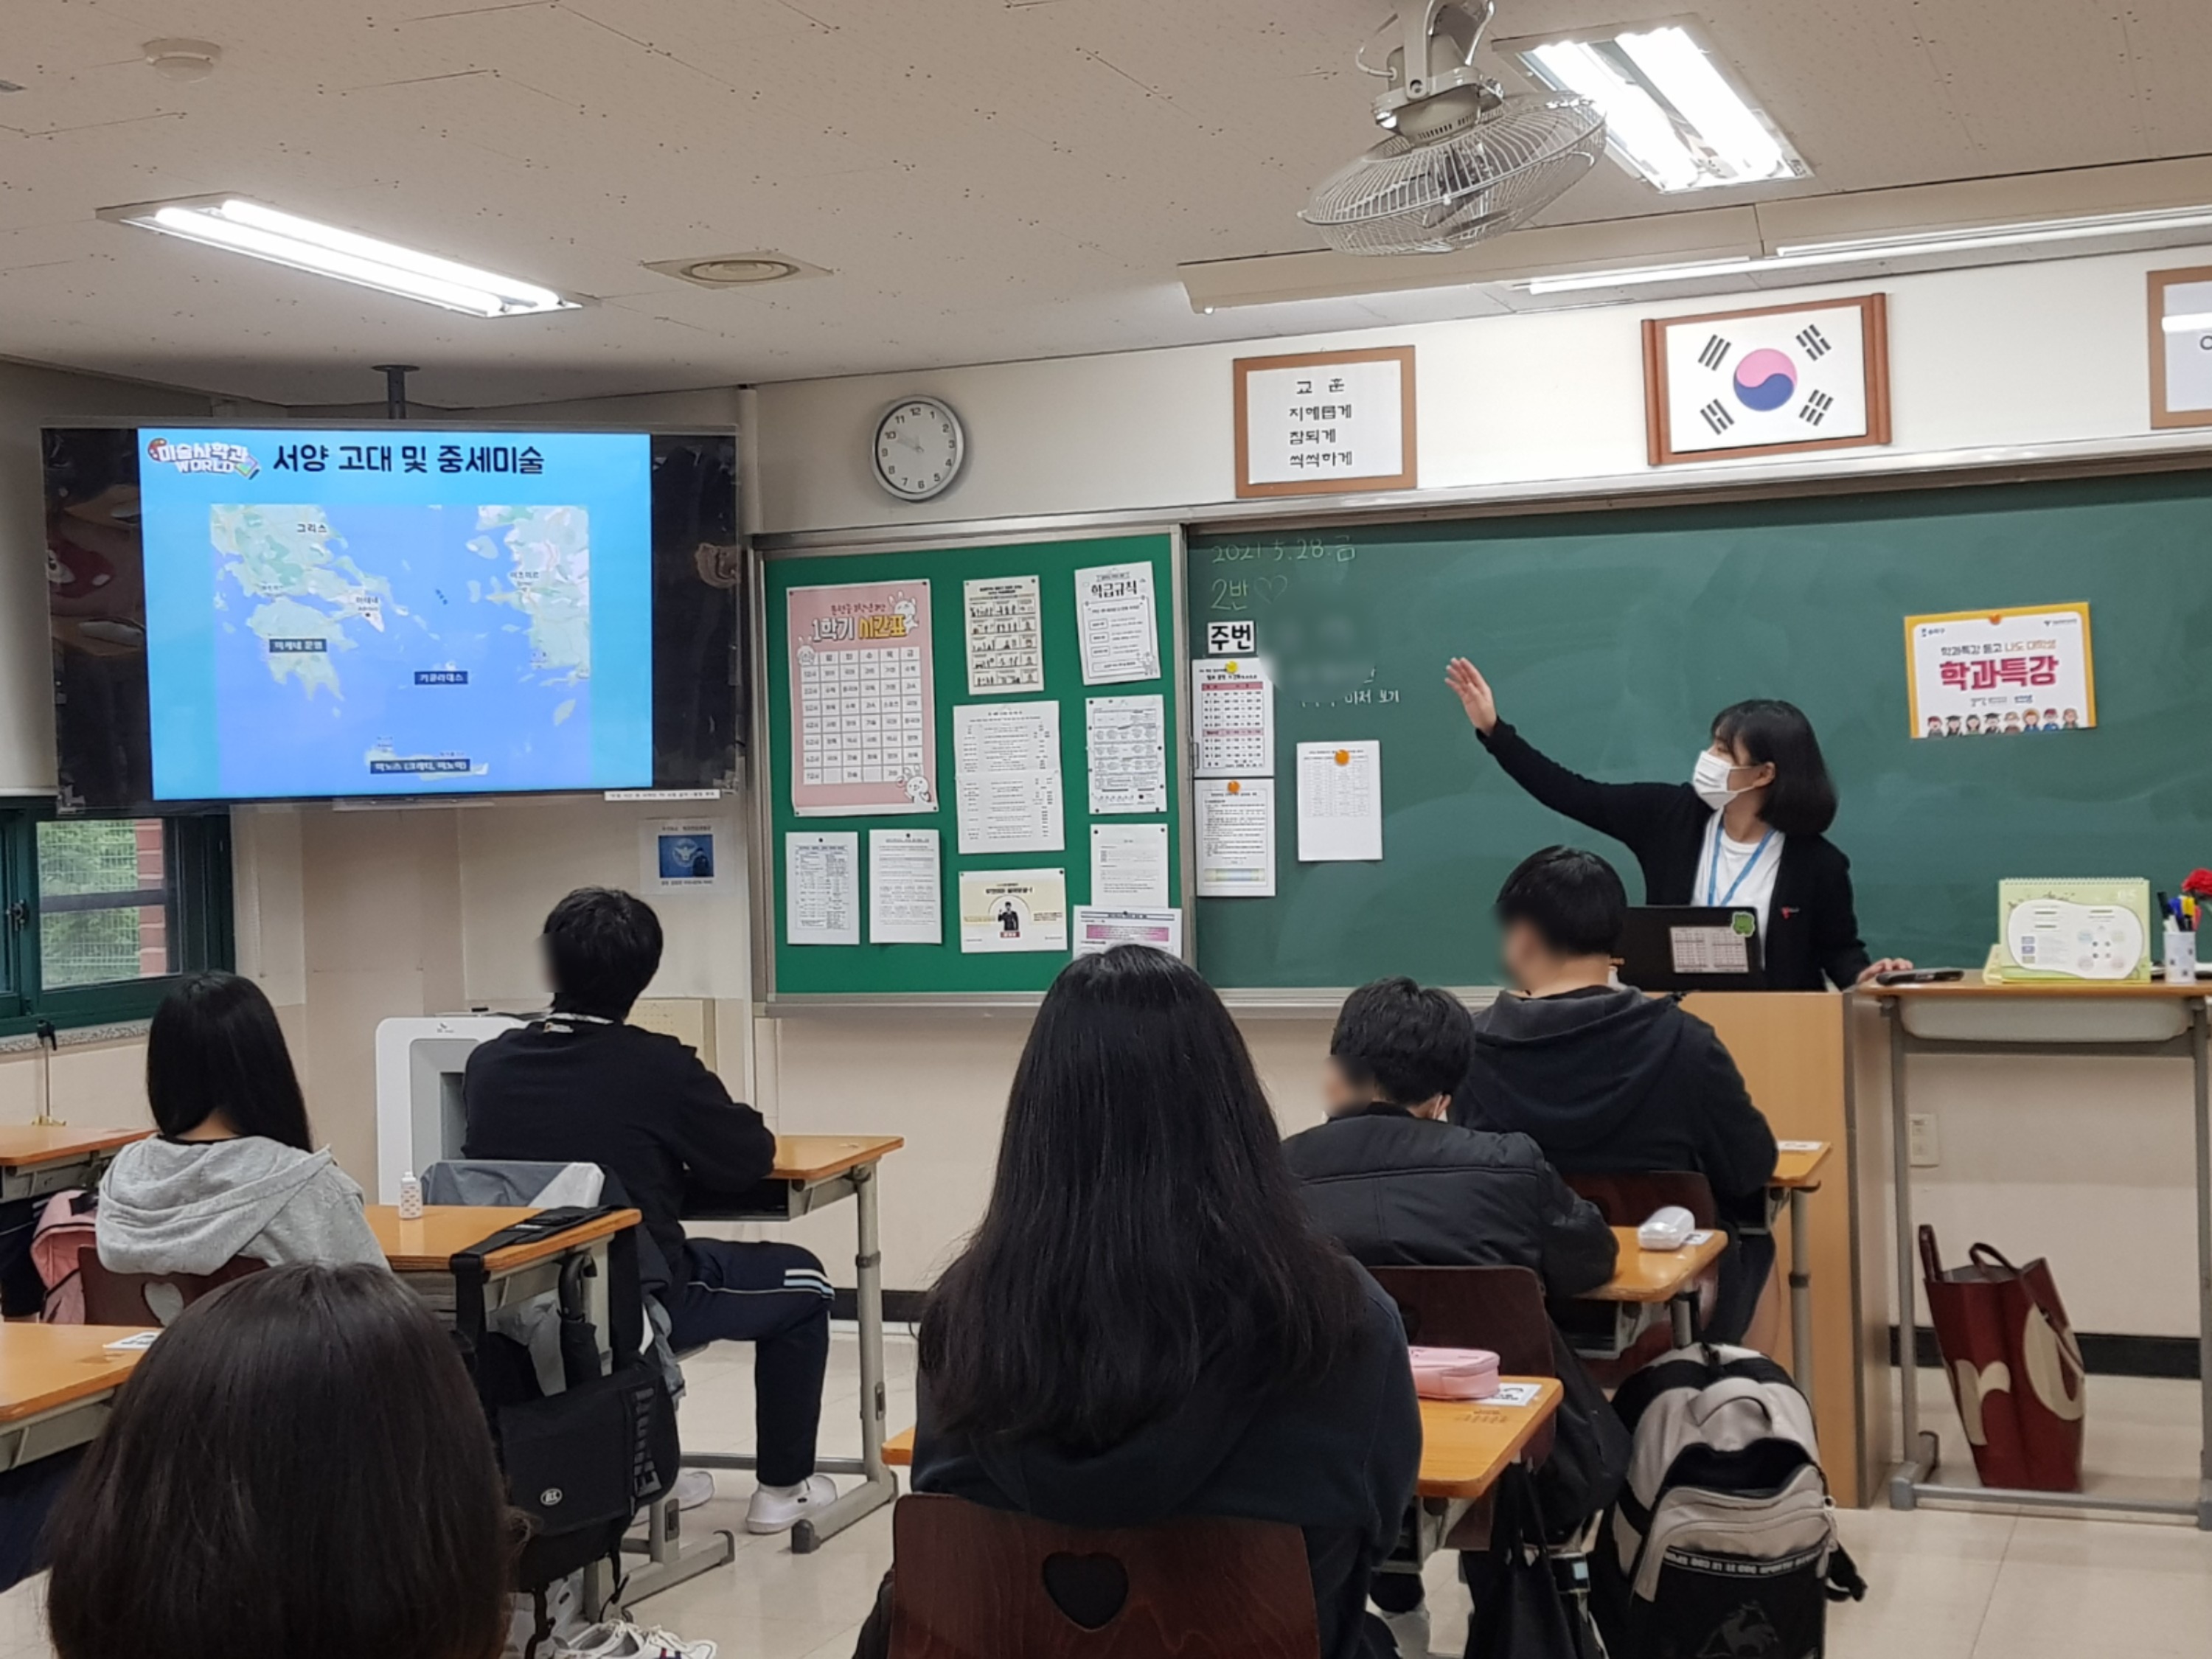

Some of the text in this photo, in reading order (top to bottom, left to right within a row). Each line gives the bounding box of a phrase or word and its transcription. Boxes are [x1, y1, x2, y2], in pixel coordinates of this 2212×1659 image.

[910, 407, 921, 416] 12
[930, 411, 935, 419] 1
[895, 415, 905, 424] 11
[942, 424, 949, 433] 2
[885, 431, 897, 439] 10
[1290, 428, 1336, 445] 참되게
[948, 440, 956, 448] 3
[158, 442, 248, 463] 미술사학과
[881, 448, 888, 456] 9
[273, 444, 545, 475] 서양 고대 및 중세미술
[945, 459, 952, 467] 4
[1289, 451, 1353, 469] 씩씩하게
[175, 459, 237, 474] WORLD
[888, 466, 895, 474] 8
[933, 473, 940, 481] 5
[902, 478, 908, 486] 7
[918, 481, 925, 489] 6
[296, 523, 327, 533] 그리스
[1091, 580, 1138, 599] 학급규칙
[1211, 578, 1248, 611] 2반
[812, 613, 908, 642] 1학기 시간표
[1211, 624, 1251, 651] 주번
[1939, 655, 2059, 691] 학과특강
